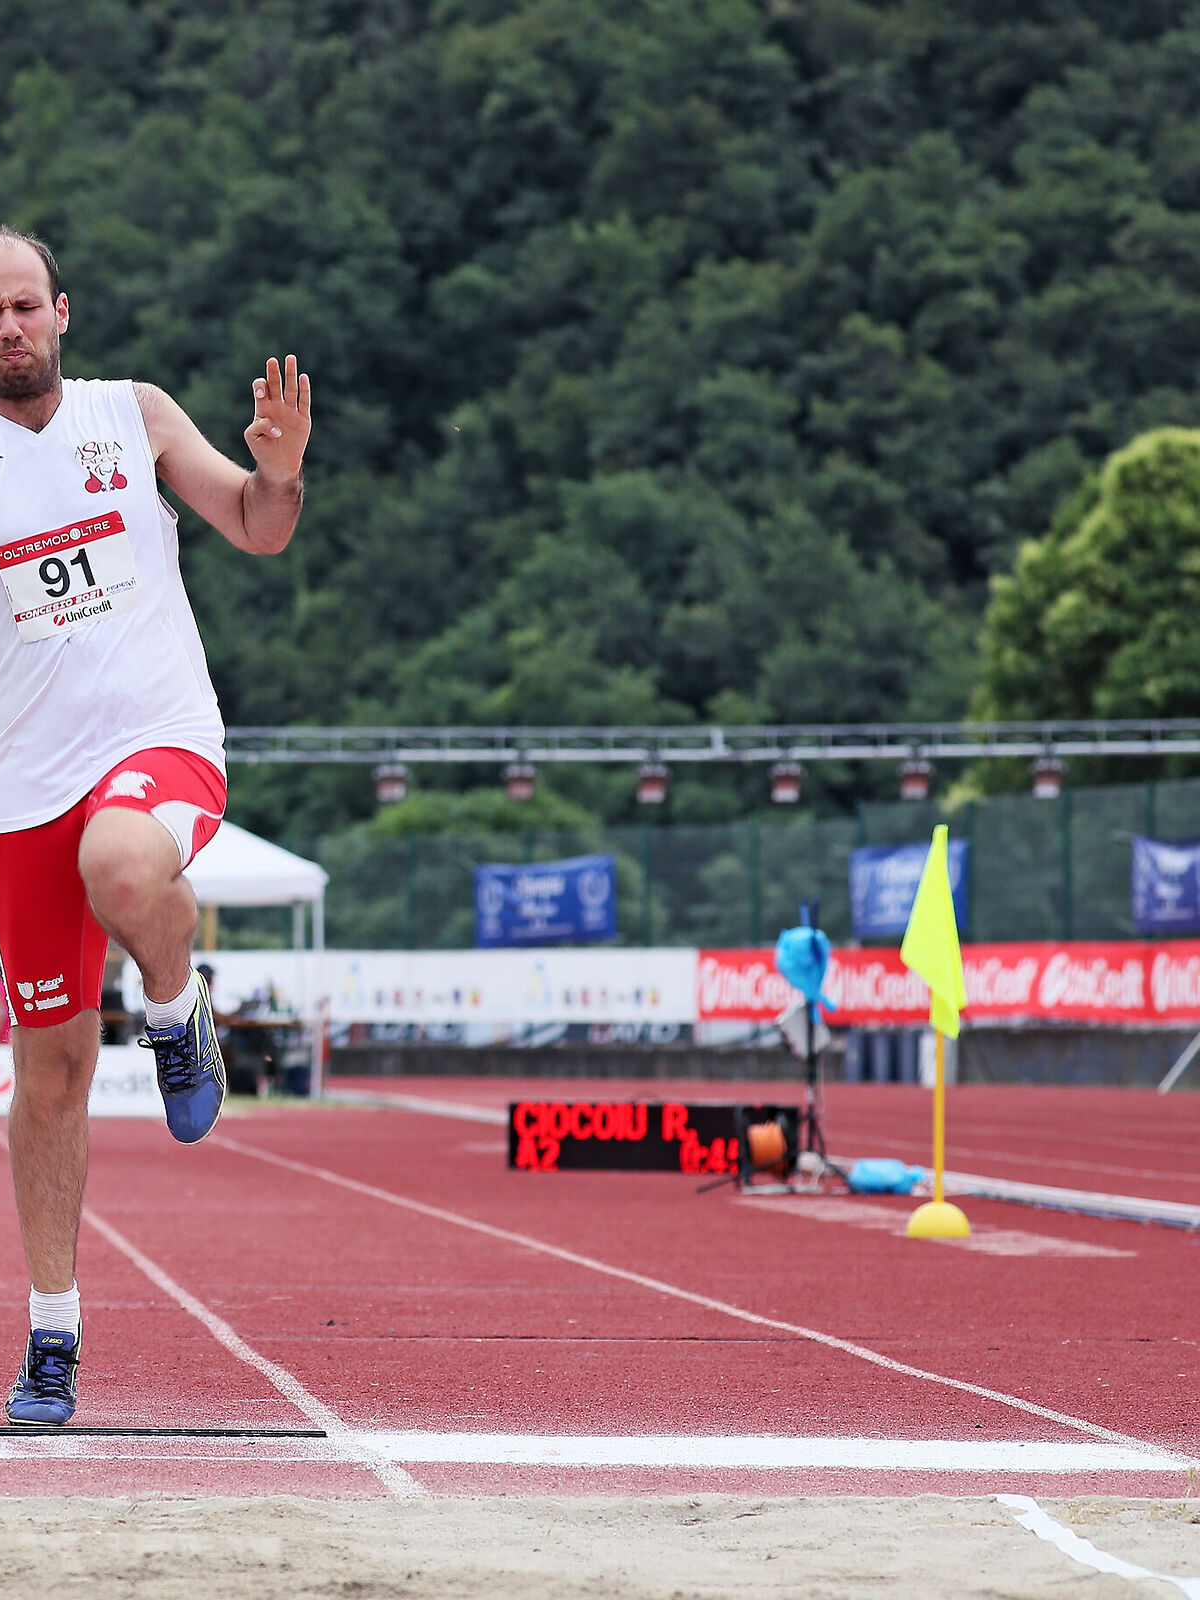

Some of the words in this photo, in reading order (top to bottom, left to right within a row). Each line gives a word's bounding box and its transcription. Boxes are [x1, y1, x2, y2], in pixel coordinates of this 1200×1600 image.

[38, 547, 96, 598] 91
[65, 599, 113, 623] UniCredit
[513, 1101, 648, 1141] CIOCOIU
[515, 1138, 561, 1172] A2
